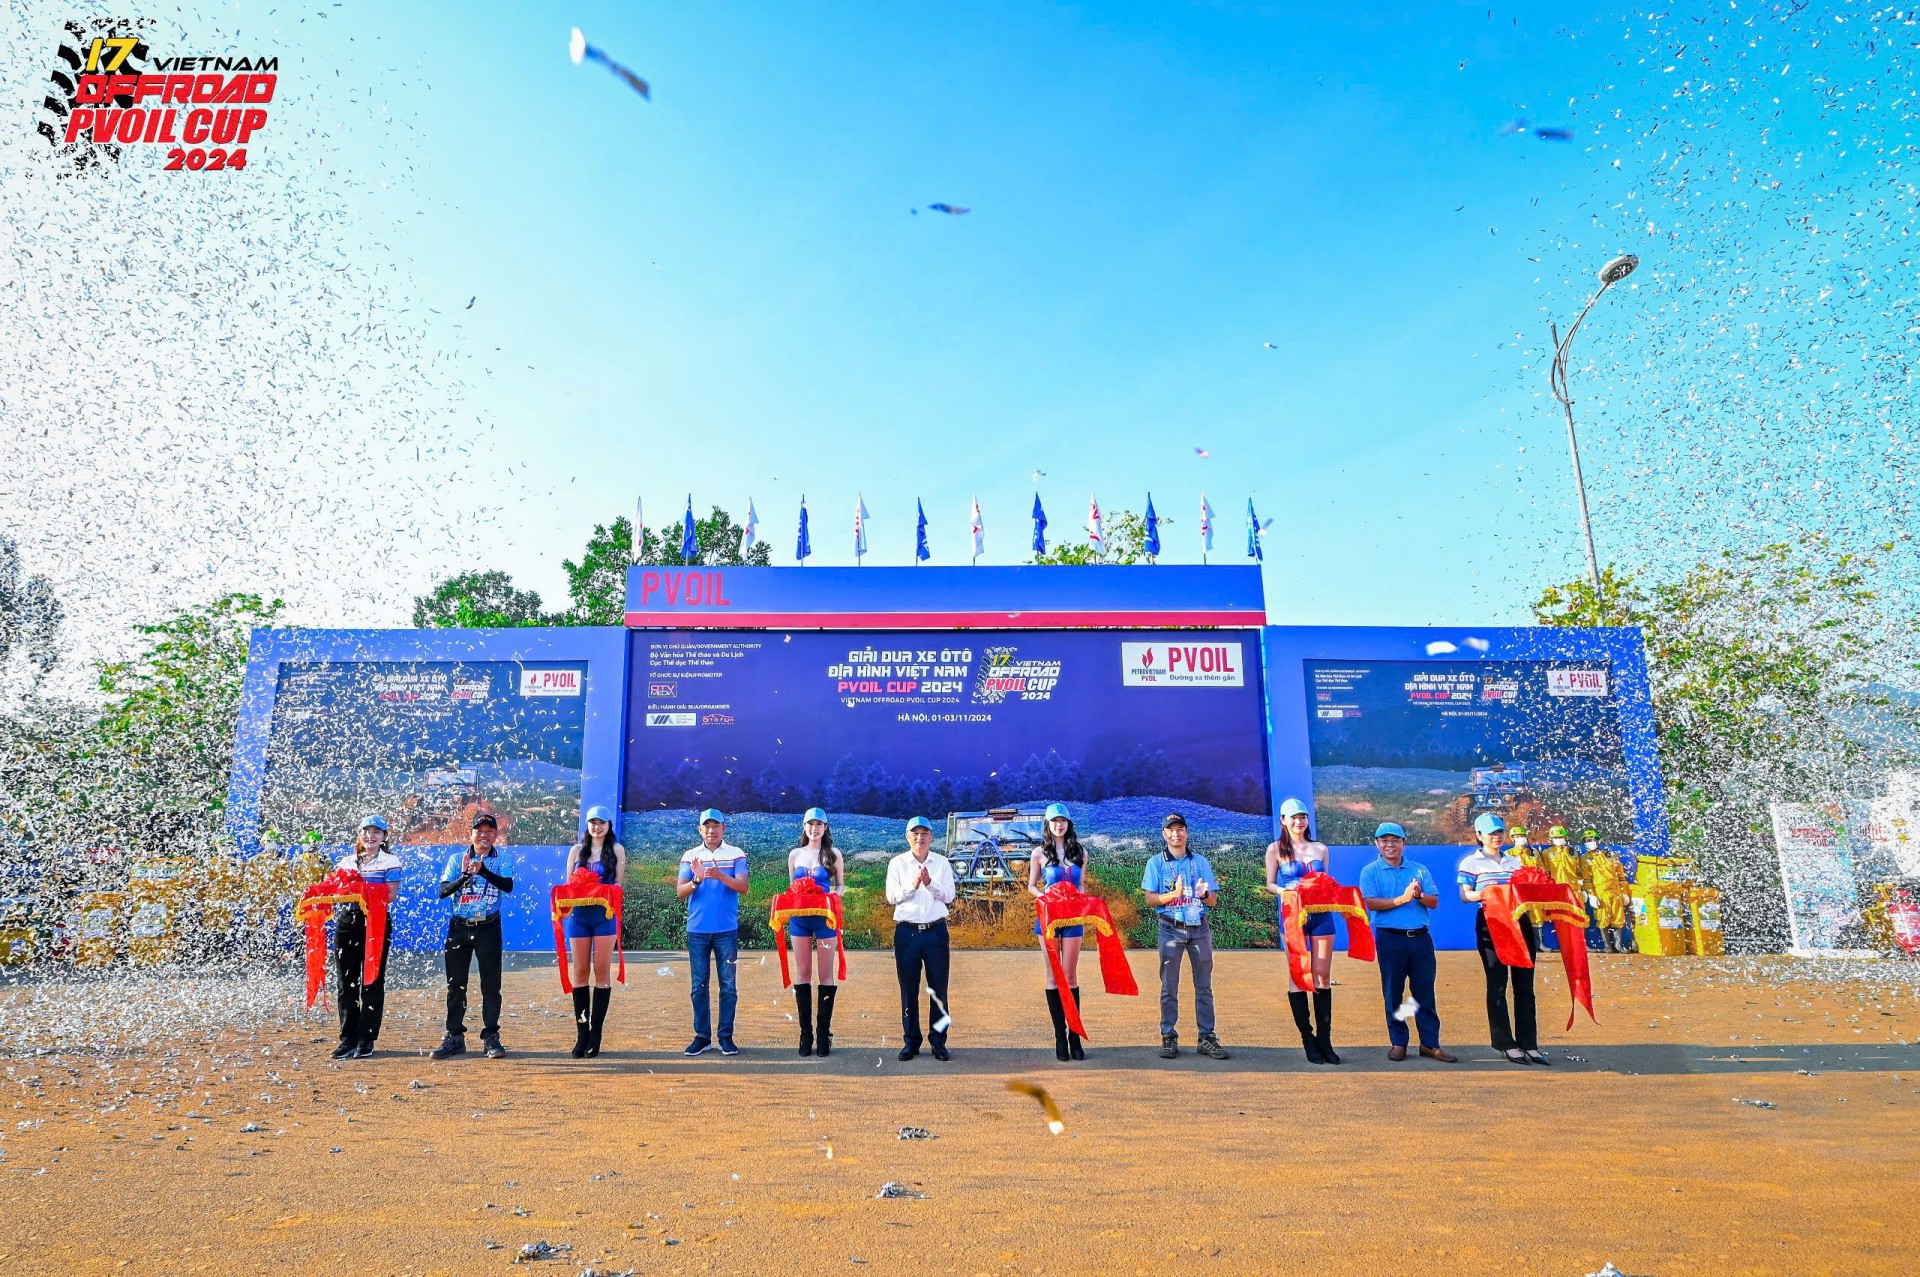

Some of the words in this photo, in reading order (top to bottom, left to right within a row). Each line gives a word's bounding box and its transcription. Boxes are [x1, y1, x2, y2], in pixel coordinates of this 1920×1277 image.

[642, 571, 730, 606] PVOIL
[848, 646, 877, 662] GIẢI
[881, 651, 912, 662] ĐUA
[915, 651, 936, 662] XE
[940, 648, 972, 662] ÔTÔ
[1168, 647, 1234, 672] PVOIL
[992, 655, 1010, 666] 17
[828, 664, 853, 680] ĐỊA
[857, 664, 891, 677] HÌNH
[894, 664, 930, 680] VIỆT
[934, 666, 967, 677] NAM
[989, 667, 1060, 676] OFFROAD
[544, 673, 576, 687] PVOIL
[1447, 674, 1457, 682] XE
[1570, 673, 1602, 688] PVOIL
[838, 682, 882, 693] PVOIL
[887, 682, 917, 693] CUP
[921, 682, 963, 693] 2024
[985, 678, 1026, 691] PVOIL
[1028, 679, 1057, 690] CUP
[1021, 692, 1051, 700] 2024
[1503, 691, 1518, 699] CUP
[898, 713, 910, 721] HÀ
[912, 713, 929, 723] NỘI,
